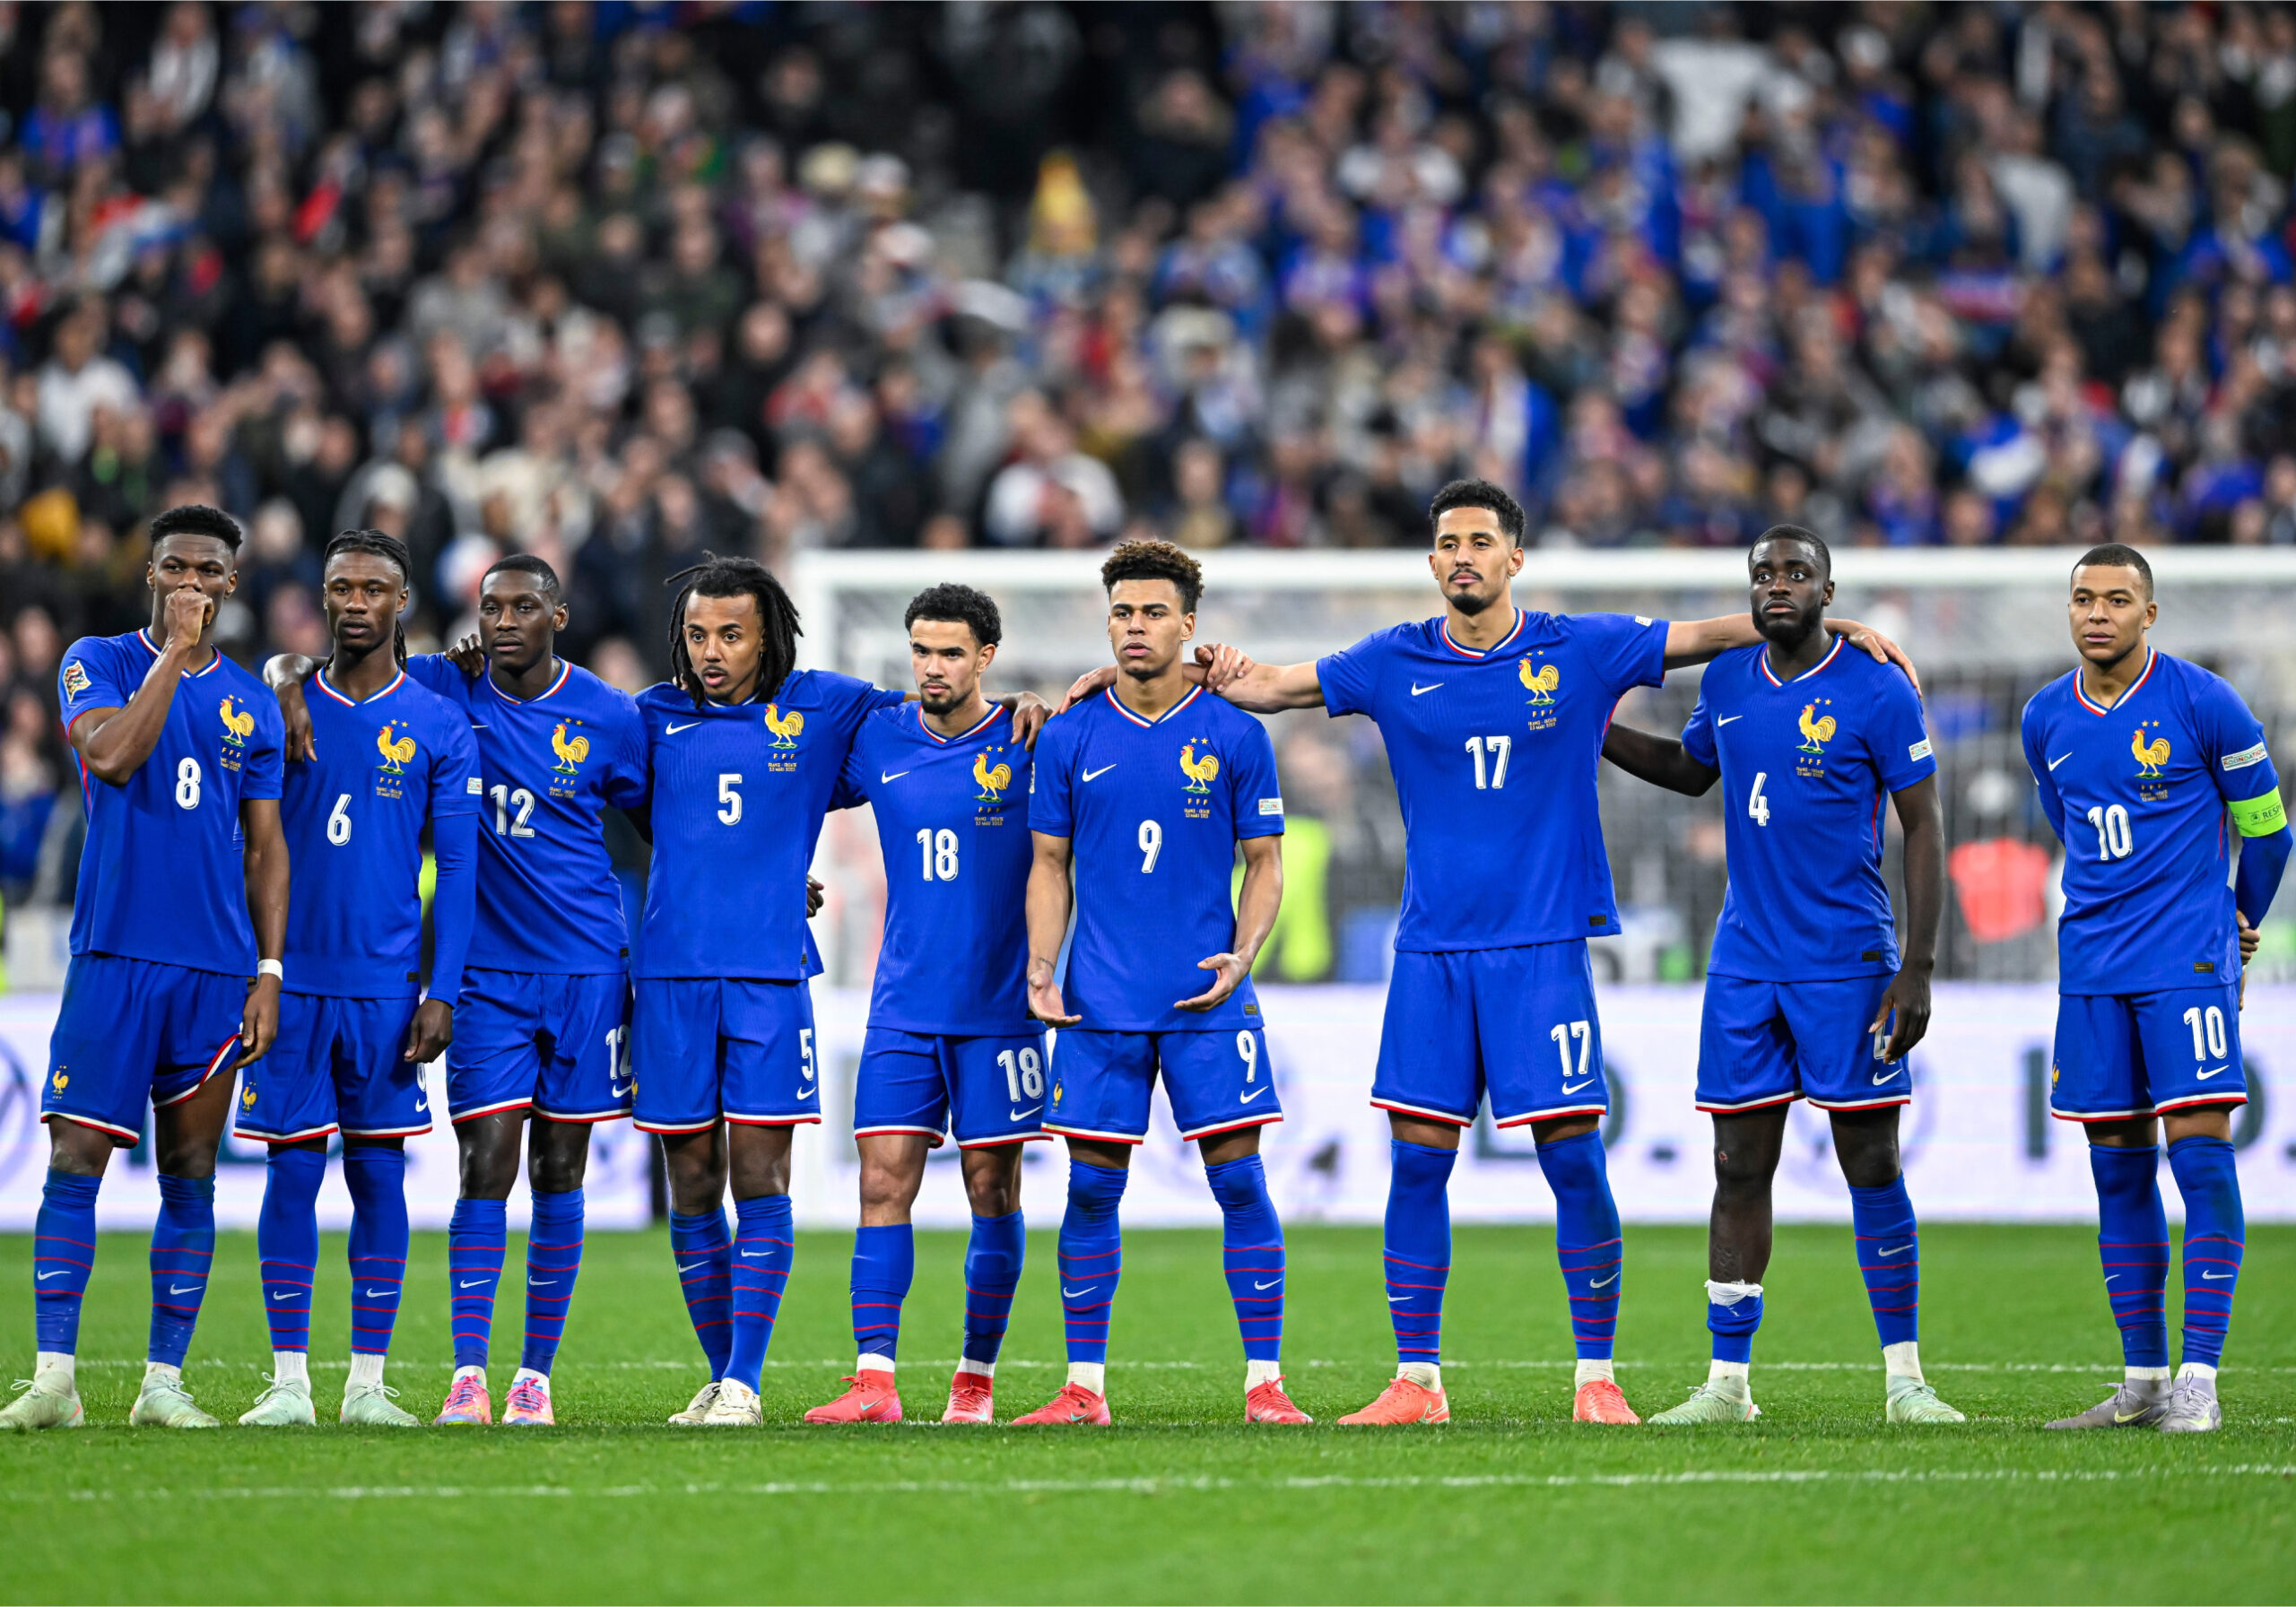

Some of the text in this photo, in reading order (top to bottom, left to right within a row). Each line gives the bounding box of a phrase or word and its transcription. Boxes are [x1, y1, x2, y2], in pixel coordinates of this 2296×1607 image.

[176, 757, 202, 810] 8
[1465, 735, 1511, 789] 17
[327, 794, 352, 847] 6
[491, 784, 535, 838] 12
[718, 773, 743, 826] 5
[1748, 772, 1770, 827] 4
[918, 828, 959, 882] 18
[1138, 819, 1162, 873] 9
[2088, 804, 2133, 861] 10
[605, 1024, 632, 1081] 12
[799, 1028, 814, 1081] 5
[1237, 1029, 1257, 1083] 9
[1550, 1020, 1591, 1077] 17
[2183, 1005, 2228, 1062] 10
[996, 1047, 1044, 1103] 18
